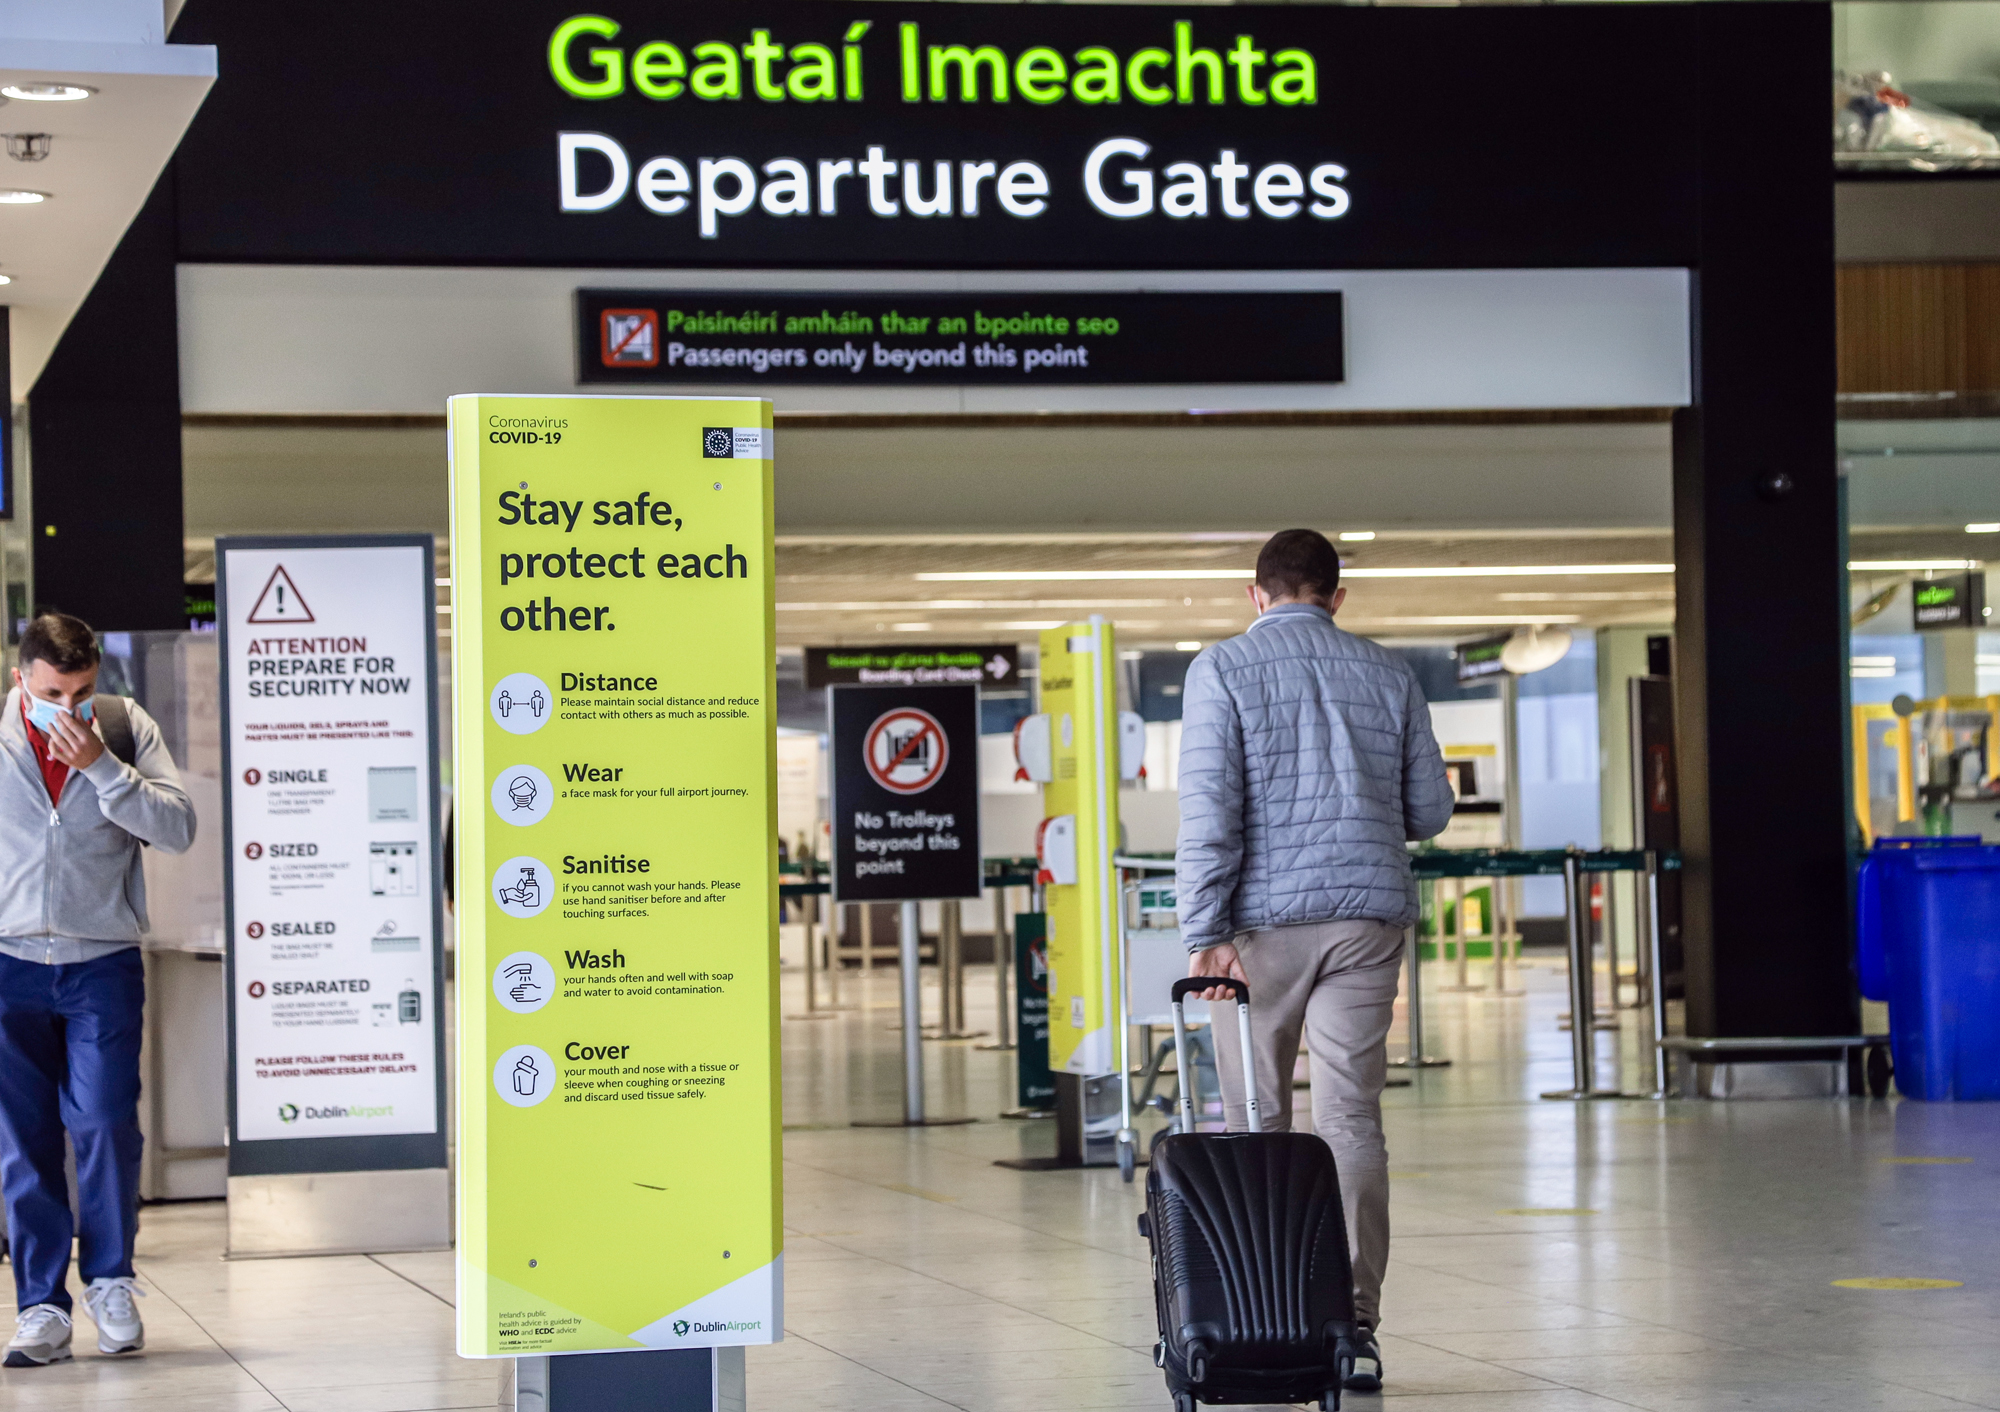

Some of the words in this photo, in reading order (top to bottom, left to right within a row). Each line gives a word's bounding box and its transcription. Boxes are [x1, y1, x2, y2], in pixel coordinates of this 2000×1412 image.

[548, 14, 871, 100] Geataí
[901, 21, 1319, 104] Imeachta
[557, 131, 1050, 238] Departure
[1084, 137, 1350, 218] Gates
[668, 310, 778, 334] Paisinéirí
[785, 311, 873, 333] amháin
[881, 311, 930, 334] thar
[937, 315, 968, 334] an
[975, 311, 1069, 339] bpointe
[1076, 316, 1119, 334] seo
[668, 344, 807, 372] Passengers
[813, 342, 866, 371] only
[873, 343, 967, 371] beyond
[973, 343, 1018, 366] this
[1024, 344, 1088, 371] point
[489, 415, 568, 429] Coronavirus
[489, 432, 561, 445] COVID-19
[498, 491, 583, 532] Stay
[593, 492, 682, 531] safe,
[501, 547, 646, 585] protect
[657, 544, 747, 578] each
[500, 597, 615, 631] other.
[247, 636, 366, 655] ATTENTION
[249, 659, 346, 676] PREPARE
[353, 658, 395, 673] FOR
[249, 679, 354, 697] SECURITY
[361, 677, 410, 694] NOW
[561, 673, 657, 691] Distance
[561, 697, 591, 706] Please
[594, 697, 634, 706] maintain
[637, 697, 663, 706] social
[667, 697, 705, 705] distance
[708, 697, 725, 705] and
[728, 696, 759, 705] reduce
[561, 710, 596, 719] contact
[599, 710, 620, 719] with
[623, 710, 653, 719] others
[668, 709, 694, 718] much
[709, 709, 749, 720] possible.
[268, 769, 327, 784] SINGLE
[562, 763, 623, 782] Wear
[570, 788, 590, 797] face
[593, 788, 617, 797] mask
[620, 788, 634, 797] for
[636, 790, 657, 799] your
[660, 787, 675, 796] full
[678, 787, 709, 798] airport
[711, 787, 749, 798] journey.
[855, 811, 883, 829] No
[887, 810, 955, 831] Trolleys
[269, 843, 318, 857] SIZED
[855, 834, 923, 855] beyond
[928, 833, 960, 850] this
[562, 855, 650, 874] Sanitise
[855, 856, 904, 879] point
[563, 883, 569, 892] if
[571, 885, 589, 893] you
[592, 883, 624, 891] cannot
[627, 882, 651, 891] wash
[654, 883, 675, 893] your
[678, 881, 708, 890] hands.
[711, 881, 741, 890] Please
[563, 897, 579, 905] use
[582, 896, 606, 905] hand
[609, 895, 648, 904] sanitiser
[651, 895, 681, 904] before
[684, 894, 701, 903] and
[704, 894, 726, 903] after
[563, 909, 605, 920] touching
[608, 908, 649, 917] surfaces.
[271, 922, 336, 936] SEALED
[565, 949, 626, 969] Wash
[564, 976, 585, 986] your
[588, 974, 616, 983] hands
[619, 973, 644, 983] often
[647, 973, 664, 982] and
[667, 972, 686, 981] well
[688, 972, 709, 981] with
[712, 973, 734, 983] soap
[272, 979, 370, 995] SEPARATED
[564, 988, 581, 997] and
[584, 989, 611, 997] water
[614, 988, 624, 996] to
[626, 986, 652, 995] avoid
[655, 985, 724, 995] contamination.
[565, 1042, 629, 1060] Cover
[255, 1056, 293, 1066] PLEASE
[296, 1055, 335, 1065] FOLLOW
[372, 1053, 404, 1062] RULES
[272, 1068, 300, 1077] AVOID
[564, 1068, 585, 1078] your
[589, 1066, 619, 1075] mouth
[622, 1065, 640, 1074] and
[643, 1066, 665, 1074] nose
[667, 1063, 688, 1073] with
[699, 1063, 726, 1072] tissue
[729, 1063, 739, 1071] or
[564, 1080, 594, 1090] sleeve
[597, 1079, 623, 1088] when
[626, 1078, 669, 1089] coughing
[672, 1078, 682, 1086] or
[684, 1076, 725, 1087] sneezing
[564, 1093, 582, 1102] and
[585, 1092, 619, 1101] discard
[621, 1091, 644, 1100] used
[647, 1090, 674, 1100] tissue
[677, 1089, 706, 1100] safely.
[550, 1318, 571, 1326] guided
[694, 1320, 761, 1333] DublinAirport
